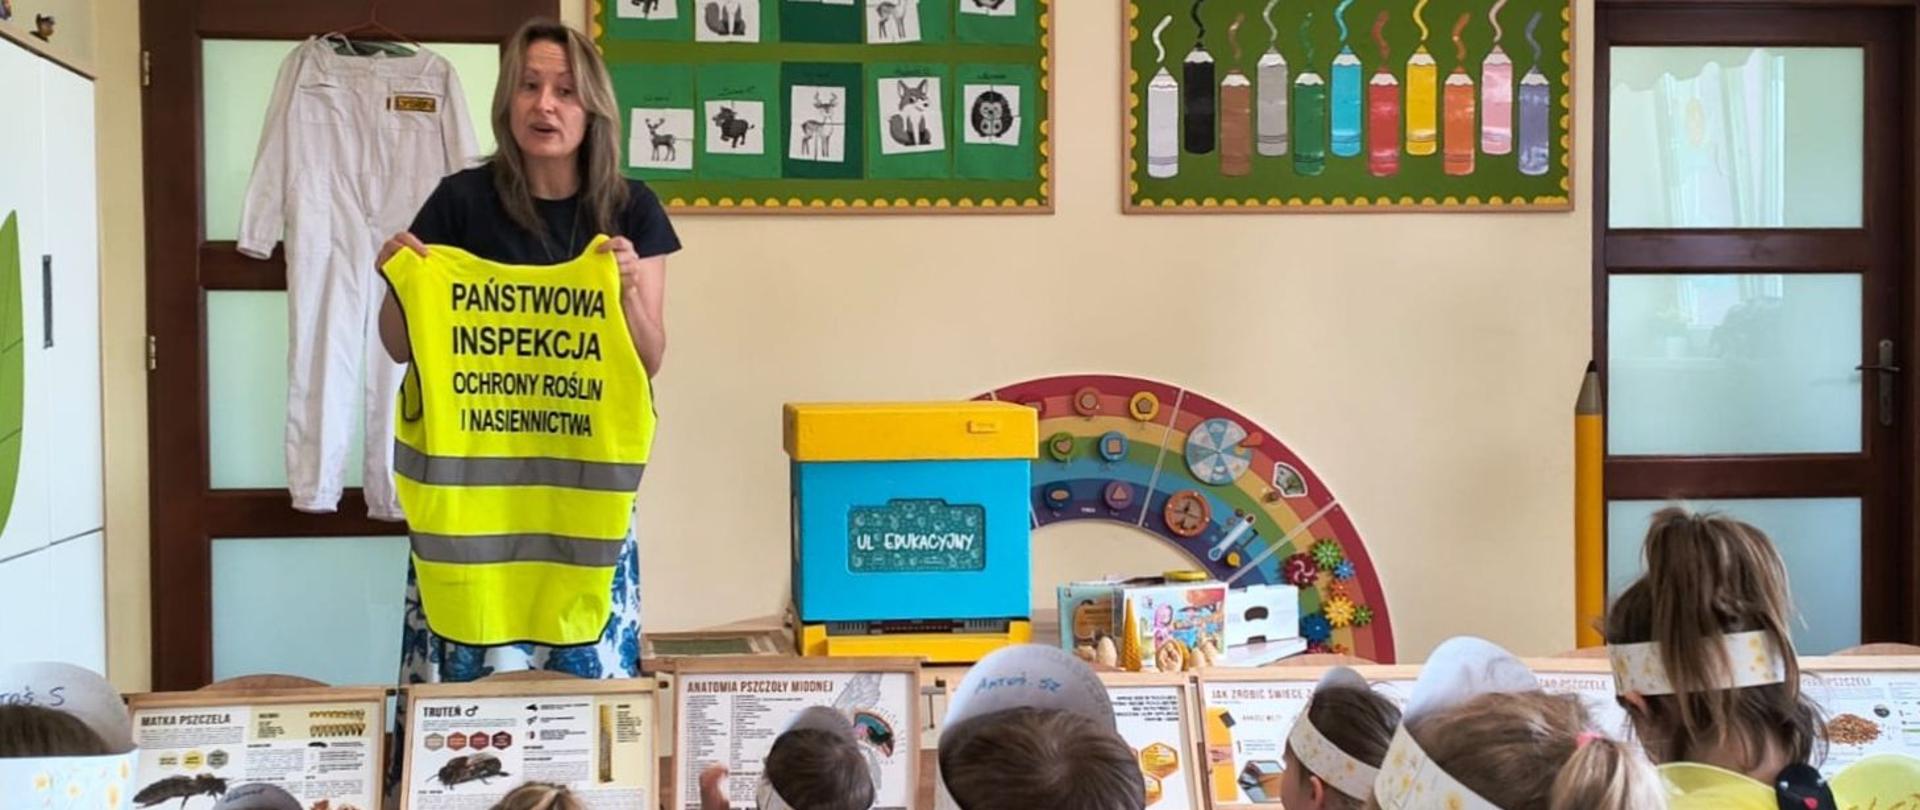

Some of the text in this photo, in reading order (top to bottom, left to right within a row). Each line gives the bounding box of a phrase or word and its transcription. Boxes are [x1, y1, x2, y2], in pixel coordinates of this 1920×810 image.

[452, 277, 606, 319] PAŃSTWOWA
[453, 326, 602, 361] INSPEKCJA
[453, 371, 603, 401] OCHRONY ROŚLIN
[461, 409, 592, 437] I NASIENNICTWA
[857, 532, 975, 552] UL EDUKACYJNY
[687, 680, 834, 693] ANATOMIA PSZCZOŁY MIODNEJ
[141, 713, 231, 727] MATKA PSZCZELA
[423, 704, 462, 718] TRUTEŃ
